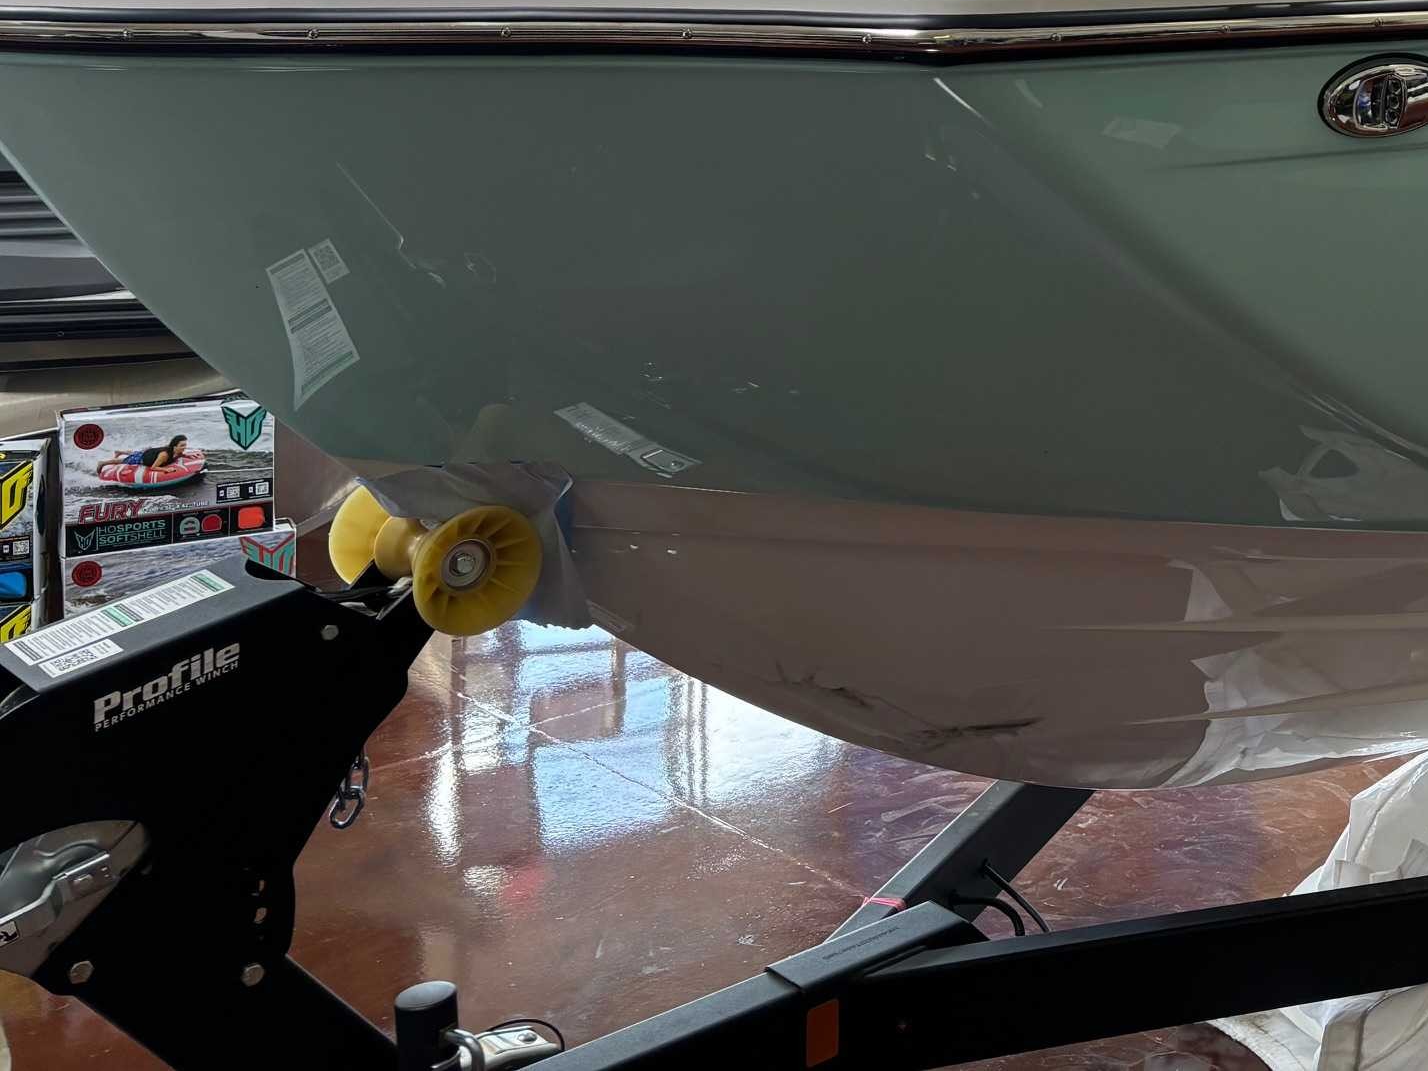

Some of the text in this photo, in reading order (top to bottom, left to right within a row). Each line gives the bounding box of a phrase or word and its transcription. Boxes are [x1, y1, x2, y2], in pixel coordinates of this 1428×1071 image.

[78, 498, 146, 525] FURY
[93, 642, 241, 725] Profile
[94, 660, 239, 733] PERFORMANCE WINCH
